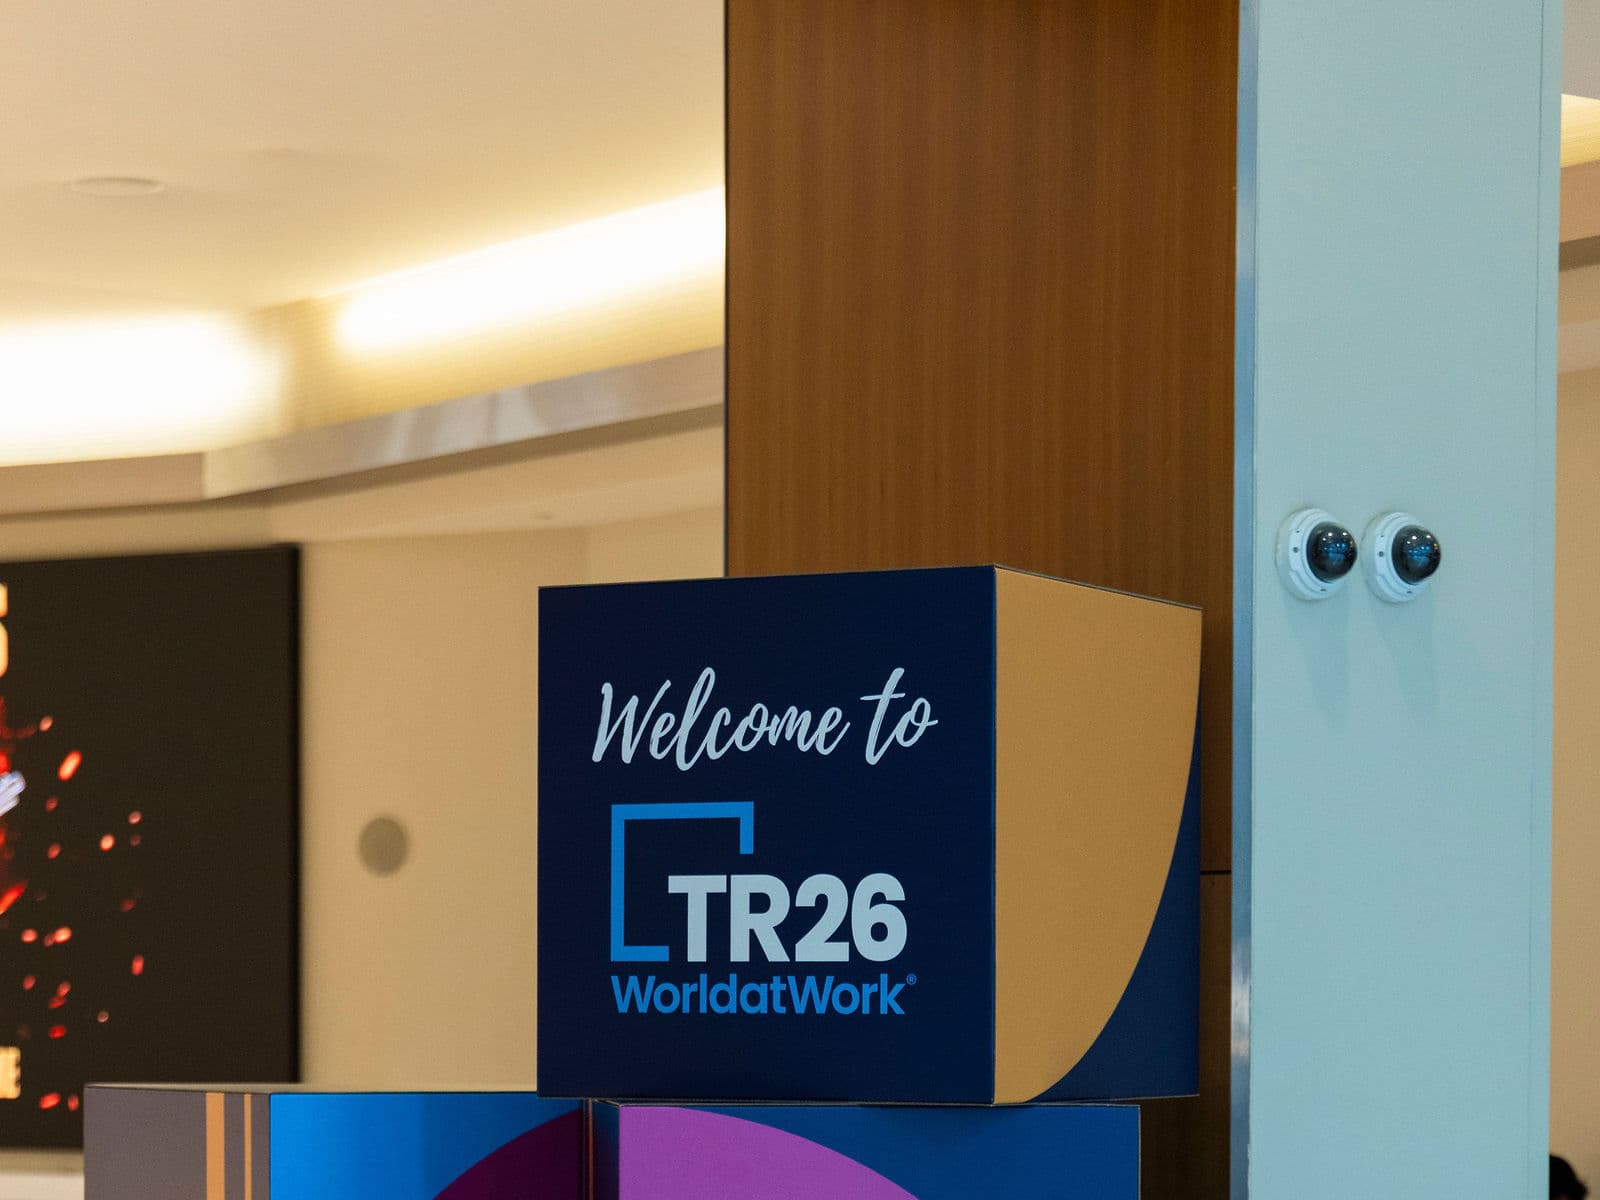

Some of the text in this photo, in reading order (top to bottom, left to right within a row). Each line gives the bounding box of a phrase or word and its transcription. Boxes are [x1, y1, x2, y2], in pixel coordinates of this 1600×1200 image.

[592, 667, 939, 771] Welcome to
[668, 873, 908, 962] TR26
